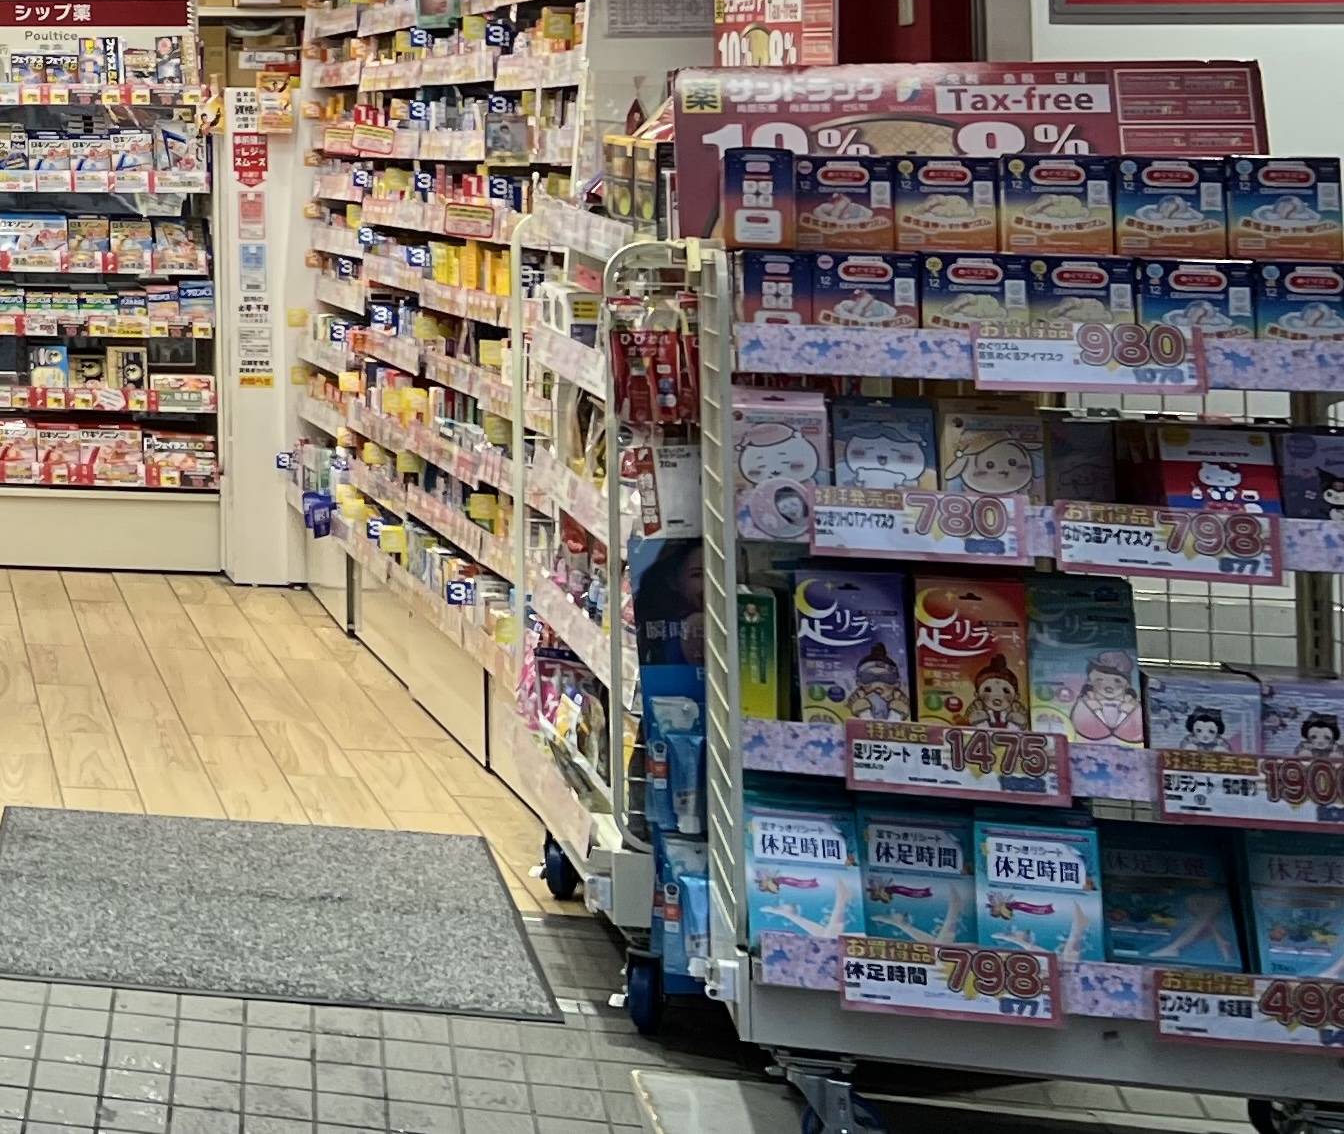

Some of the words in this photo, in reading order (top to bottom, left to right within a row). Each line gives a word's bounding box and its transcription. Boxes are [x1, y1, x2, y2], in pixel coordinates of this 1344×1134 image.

[14, 3, 92, 23] シップ薬
[25, 31, 78, 41] Poultice
[684, 80, 720, 113] 薬
[726, 77, 883, 103] サンドラッグ
[949, 87, 1096, 113] Tax-free
[1077, 323, 1186, 367] 980
[905, 493, 1010, 539] 780
[1157, 510, 1266, 558] 798
[946, 728, 1050, 777] 1475
[761, 834, 842, 861] 休足時間
[876, 842, 958, 870] 休足時間
[995, 856, 1080, 885] 休足時間
[846, 938, 932, 963] お買得品
[845, 961, 928, 986] 休足時間
[938, 947, 1043, 998] 798
